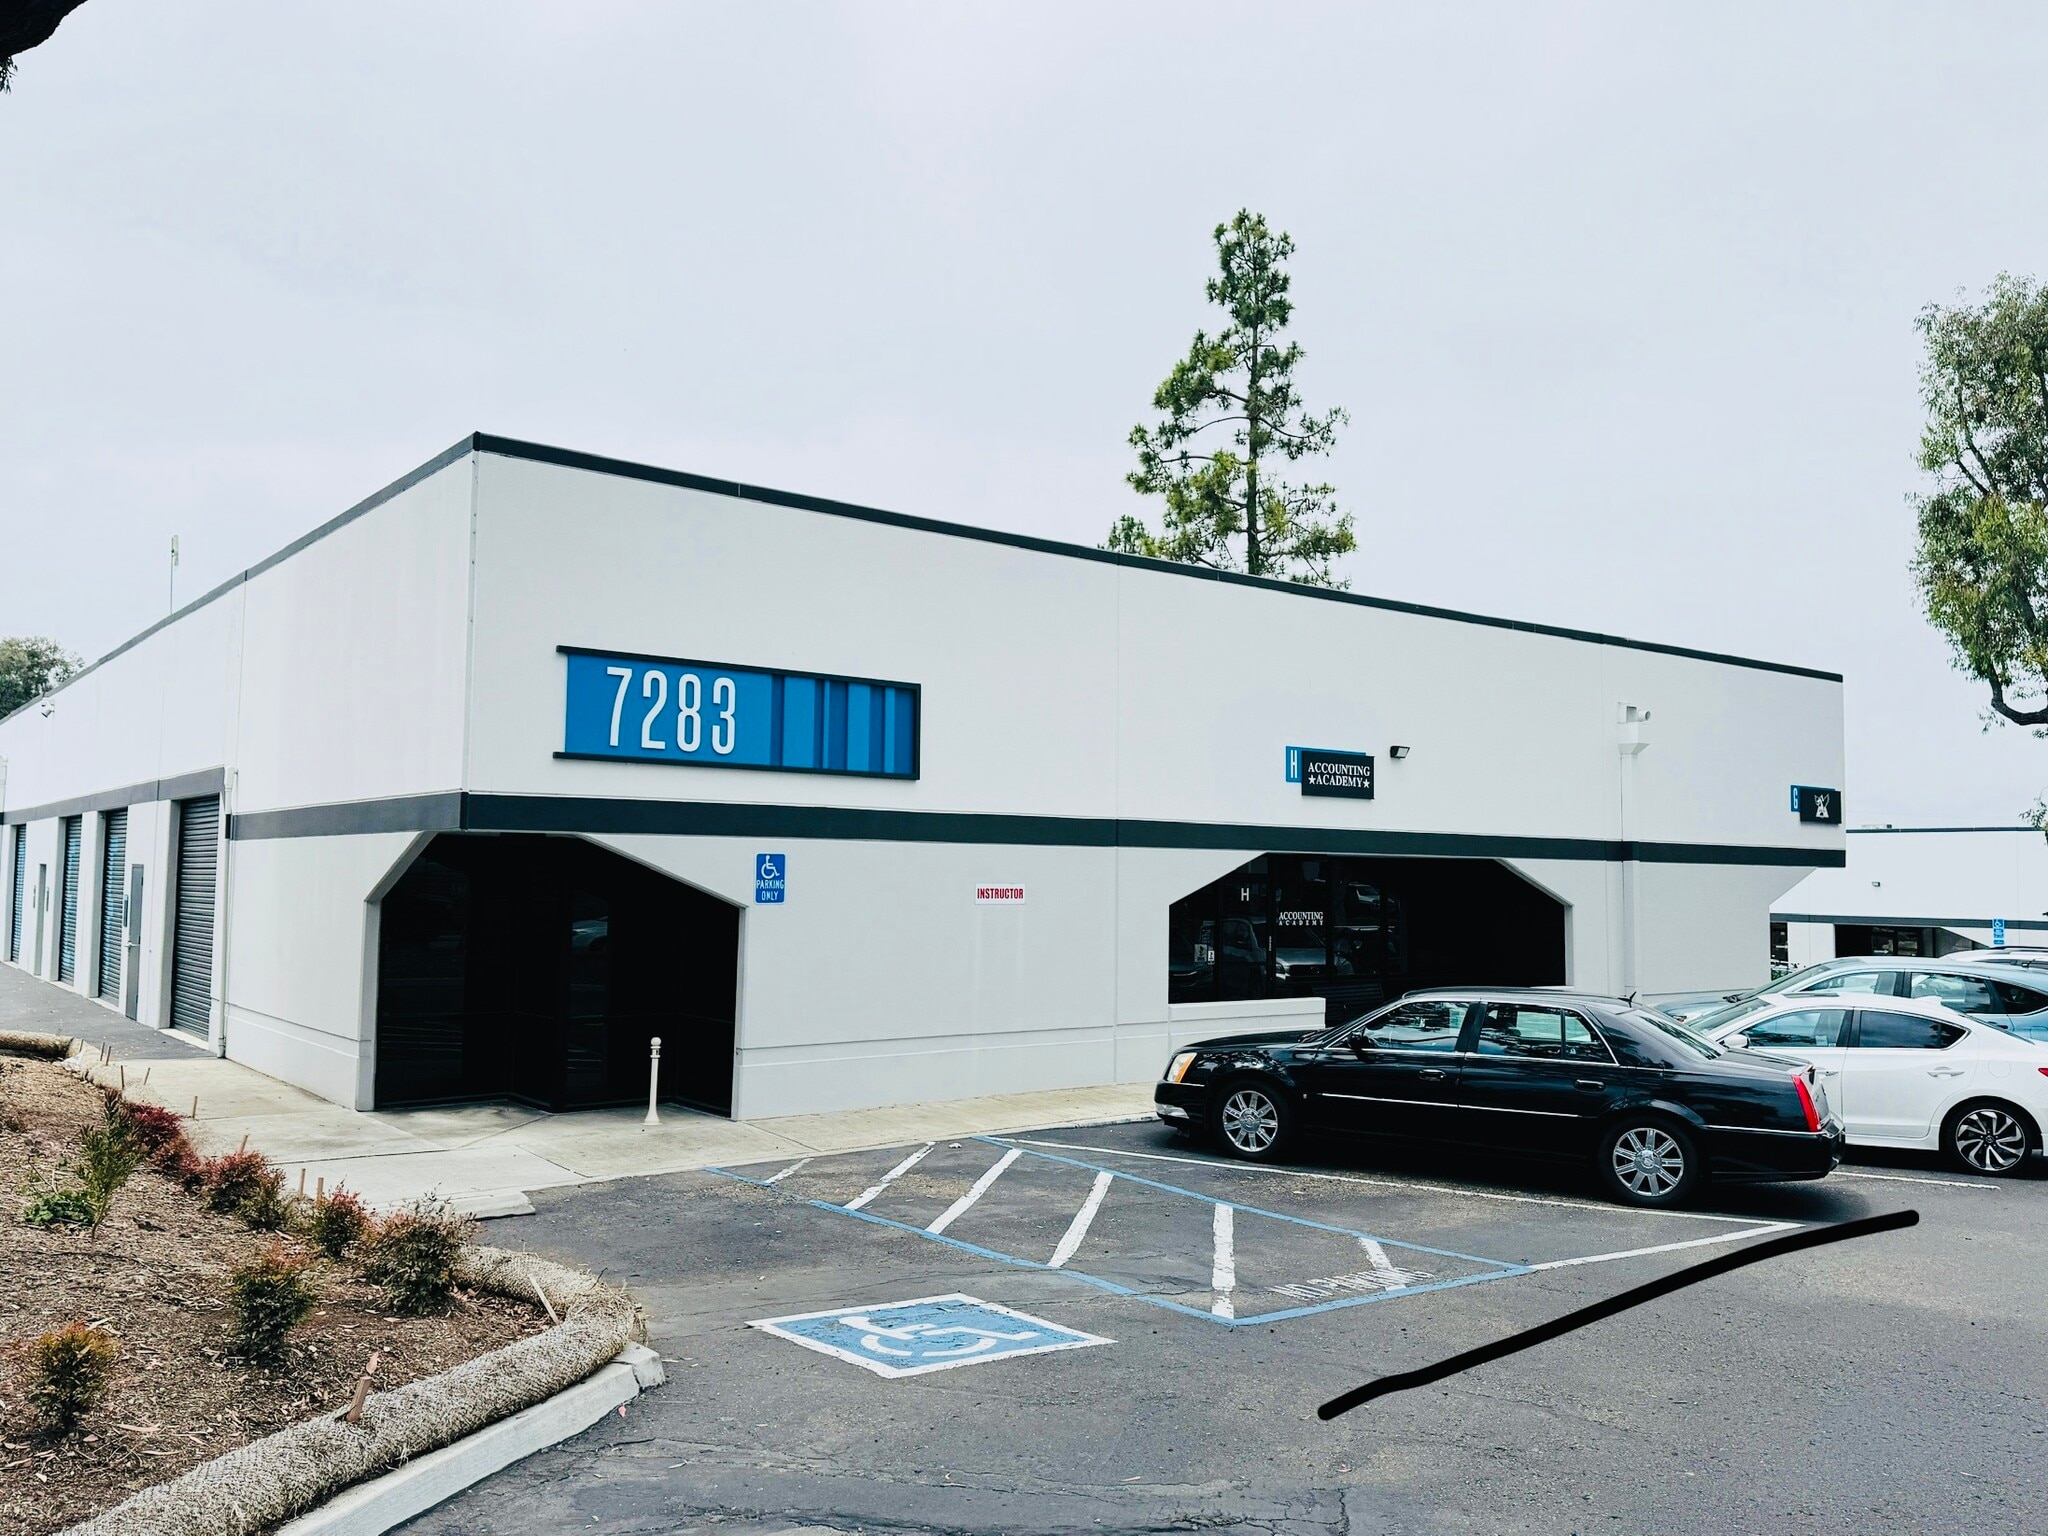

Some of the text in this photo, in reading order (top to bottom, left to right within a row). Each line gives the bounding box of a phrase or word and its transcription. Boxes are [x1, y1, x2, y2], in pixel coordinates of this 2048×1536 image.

[607, 666, 736, 755] 7283
[1290, 749, 1298, 779] H
[1308, 762, 1371, 777] ACCOUNTING
[1316, 774, 1363, 788] ACADEMY
[756, 879, 785, 890] PARKING
[761, 890, 779, 901] ONLY
[977, 888, 1024, 899] INSTRUCTOR
[1241, 887, 1250, 902] H
[1278, 911, 1324, 920] ACCOUNTING
